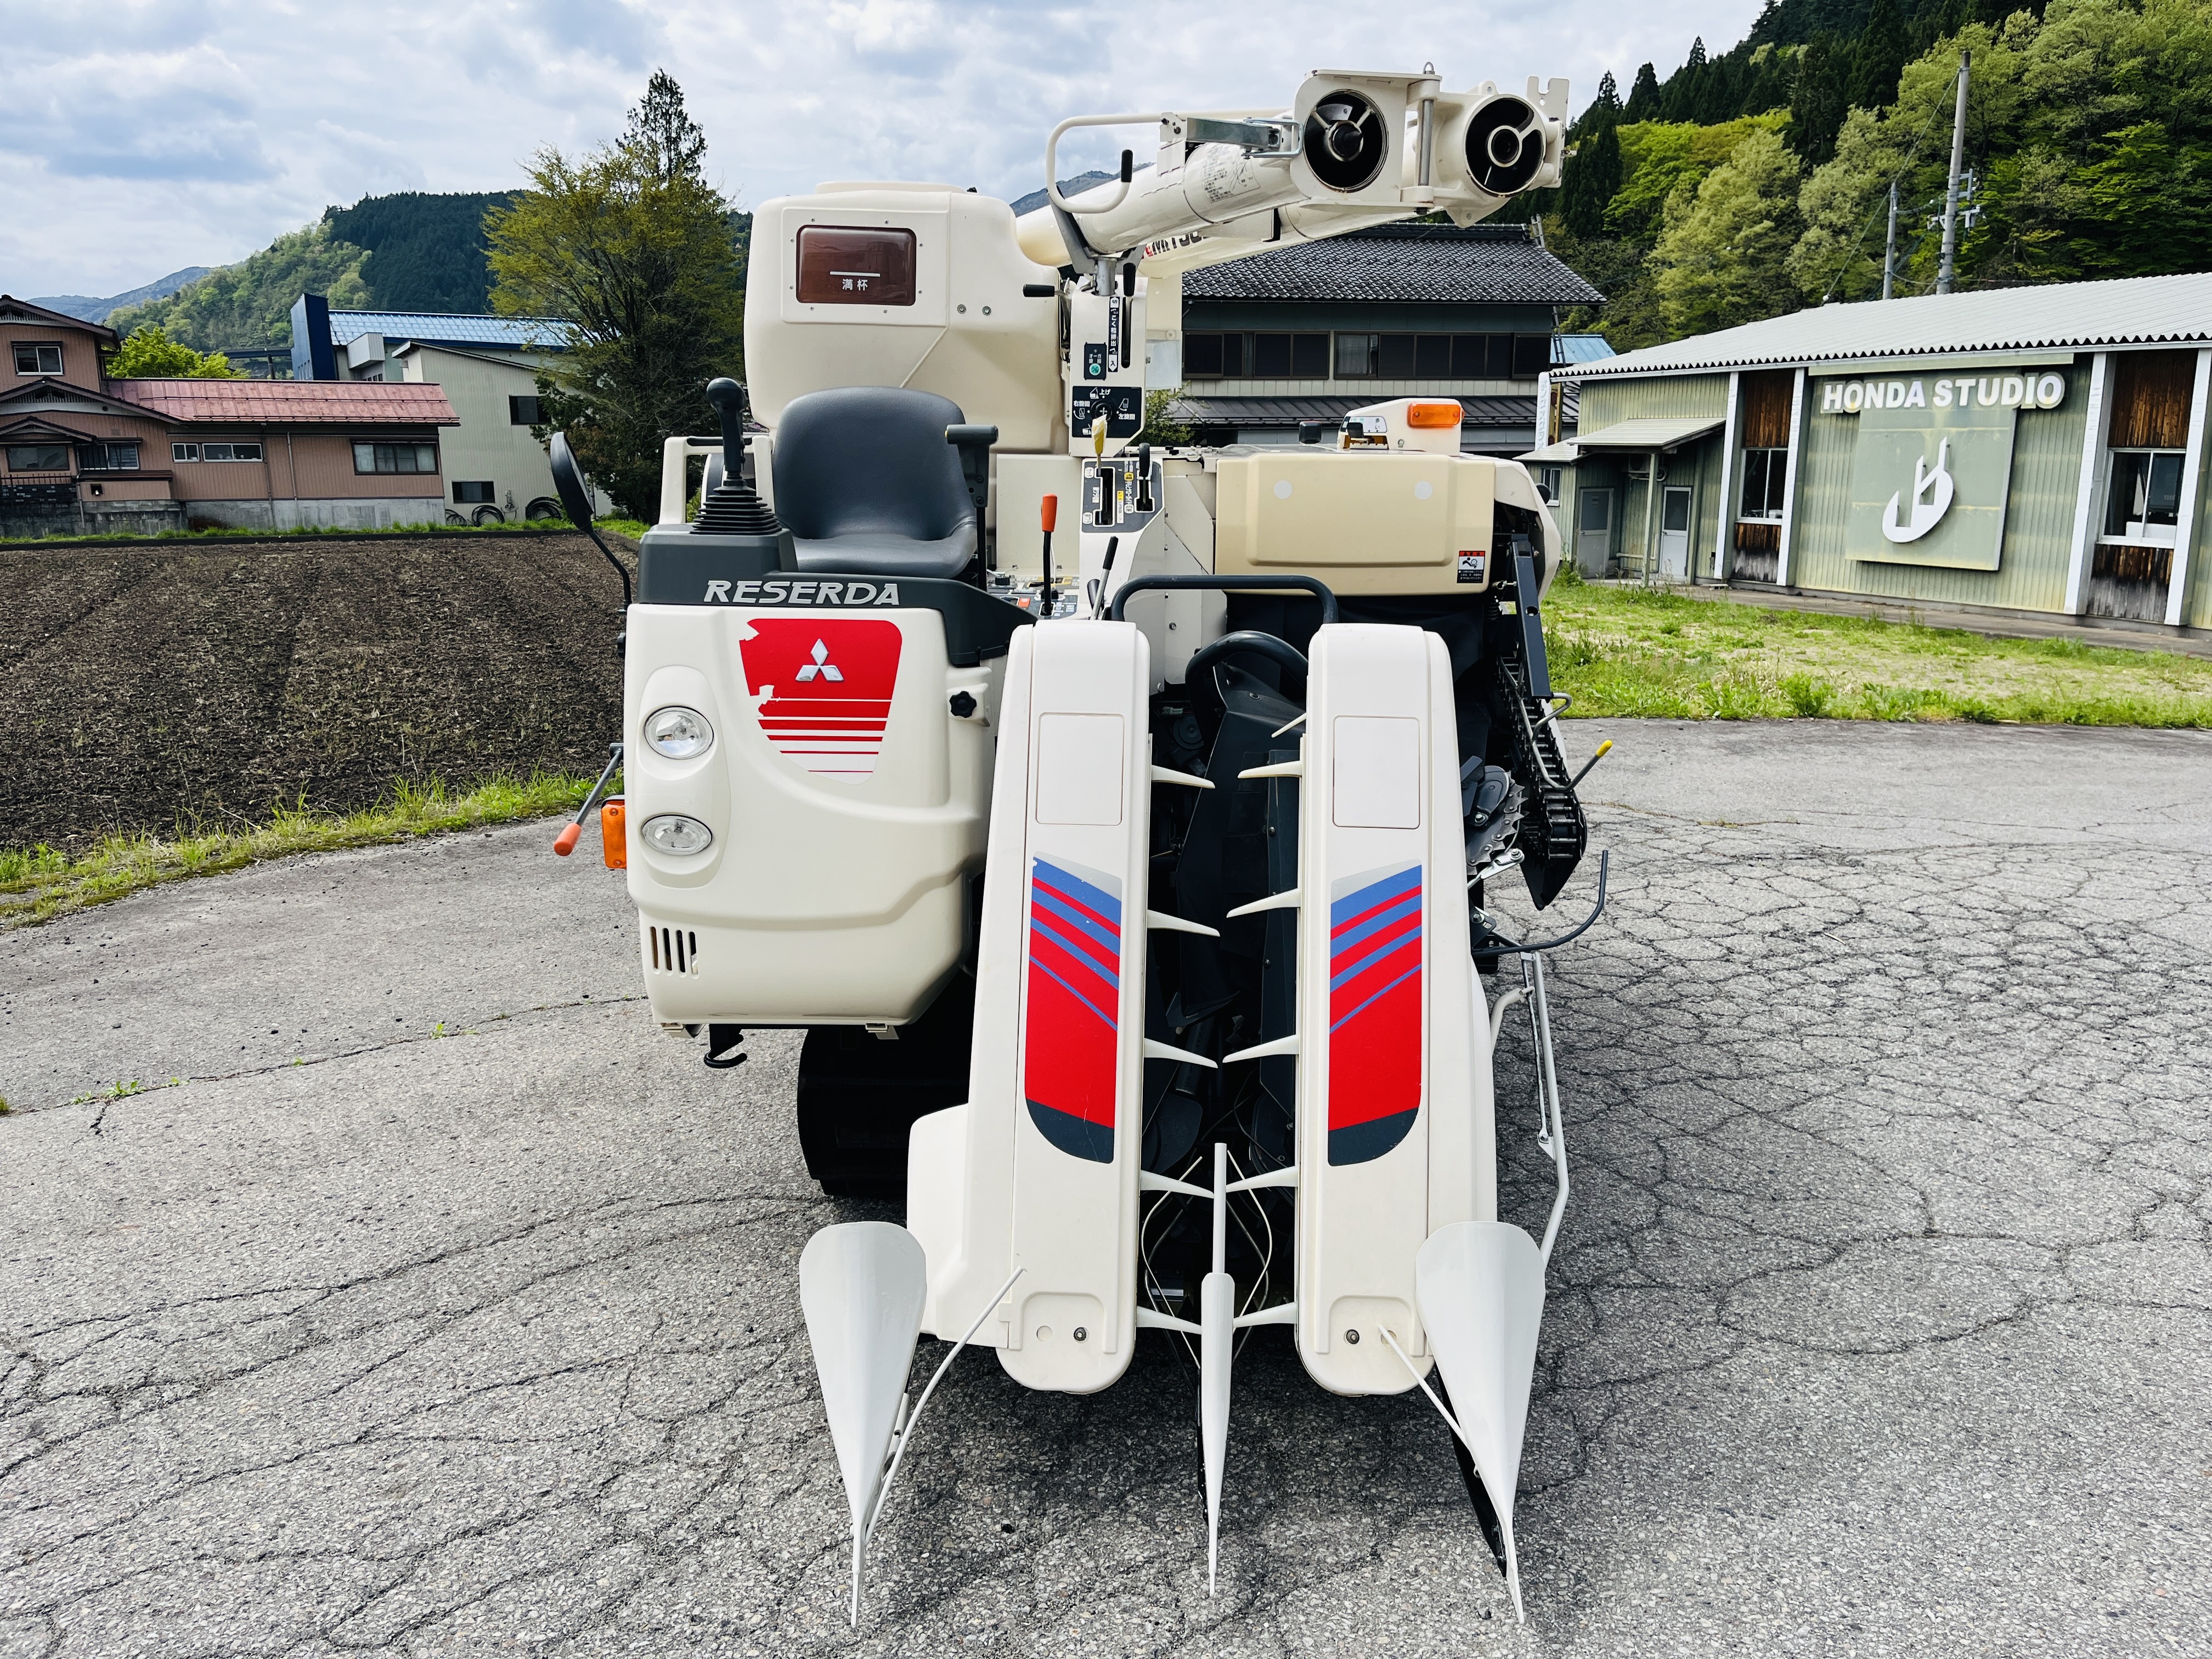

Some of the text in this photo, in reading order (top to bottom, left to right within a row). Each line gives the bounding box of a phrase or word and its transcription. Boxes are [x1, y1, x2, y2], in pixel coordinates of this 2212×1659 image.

[842, 279, 868, 291] 満杯
[1822, 375, 2063, 410] HONDA STUDIO
[703, 580, 900, 606] RESERDA
